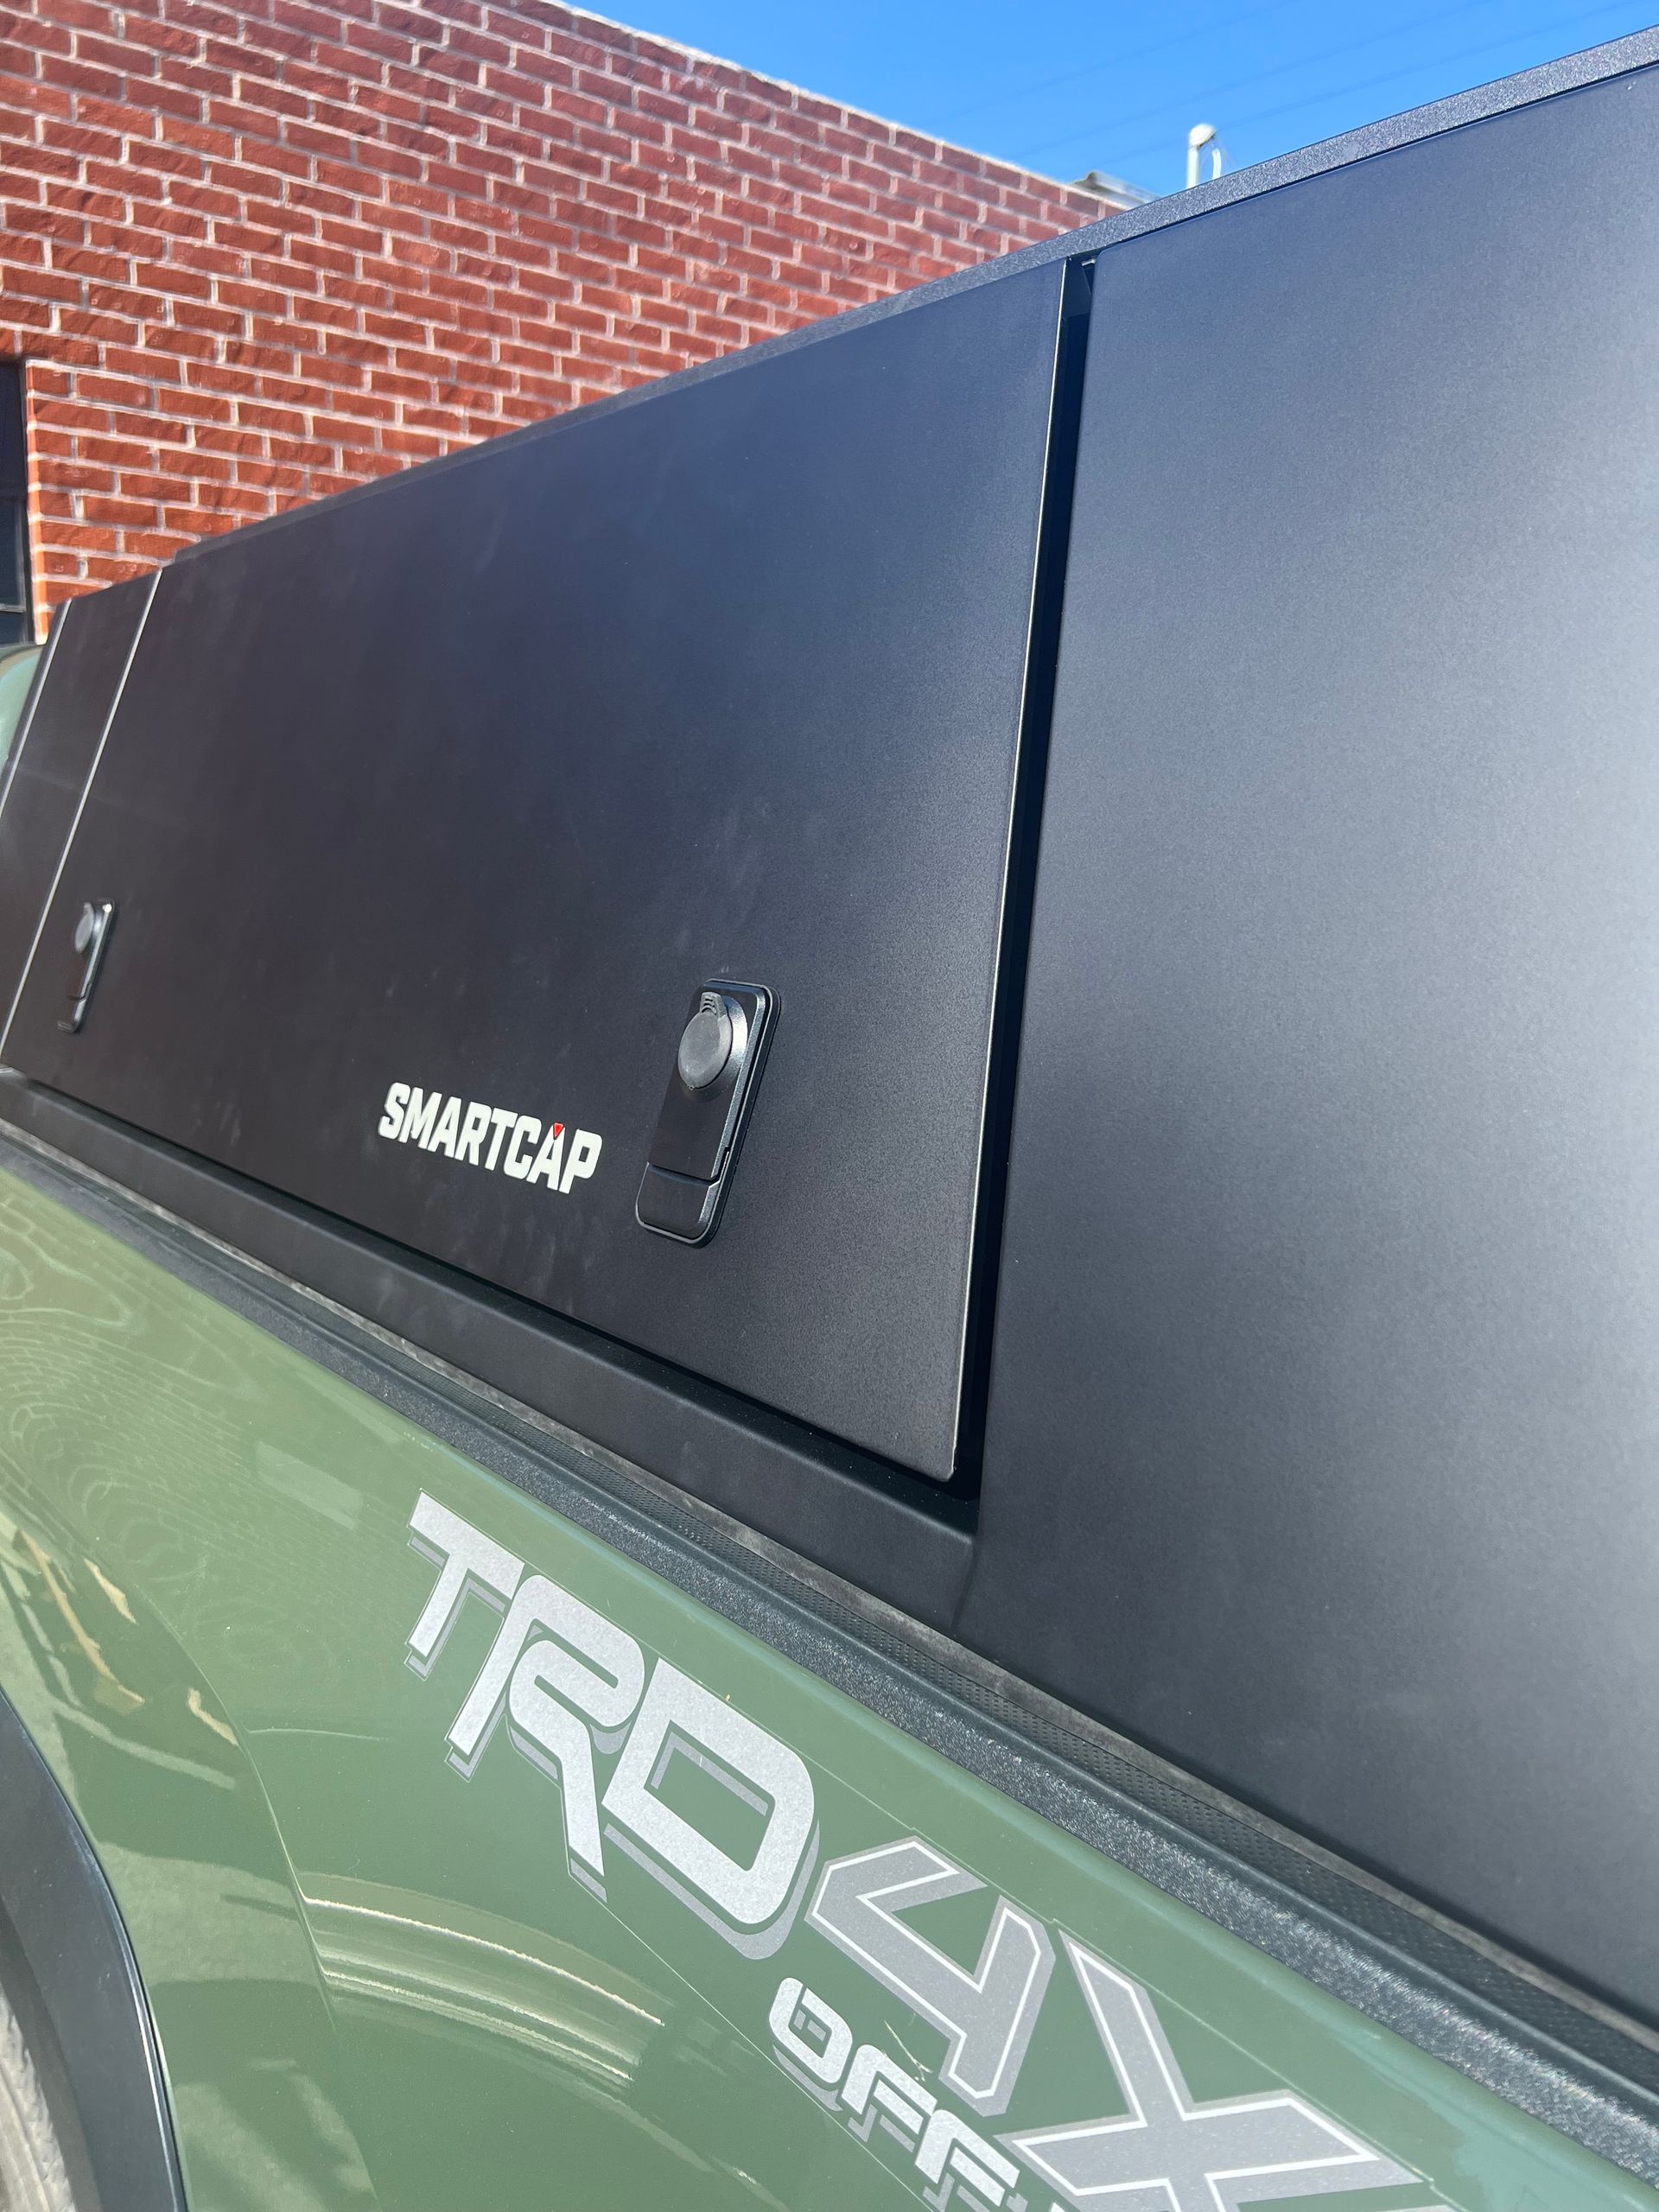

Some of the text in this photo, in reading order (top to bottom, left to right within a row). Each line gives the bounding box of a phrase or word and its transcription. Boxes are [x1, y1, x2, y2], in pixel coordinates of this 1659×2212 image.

[378, 1082, 603, 1194] SMARTCAP
[406, 1491, 1460, 2212] TRD 4X
